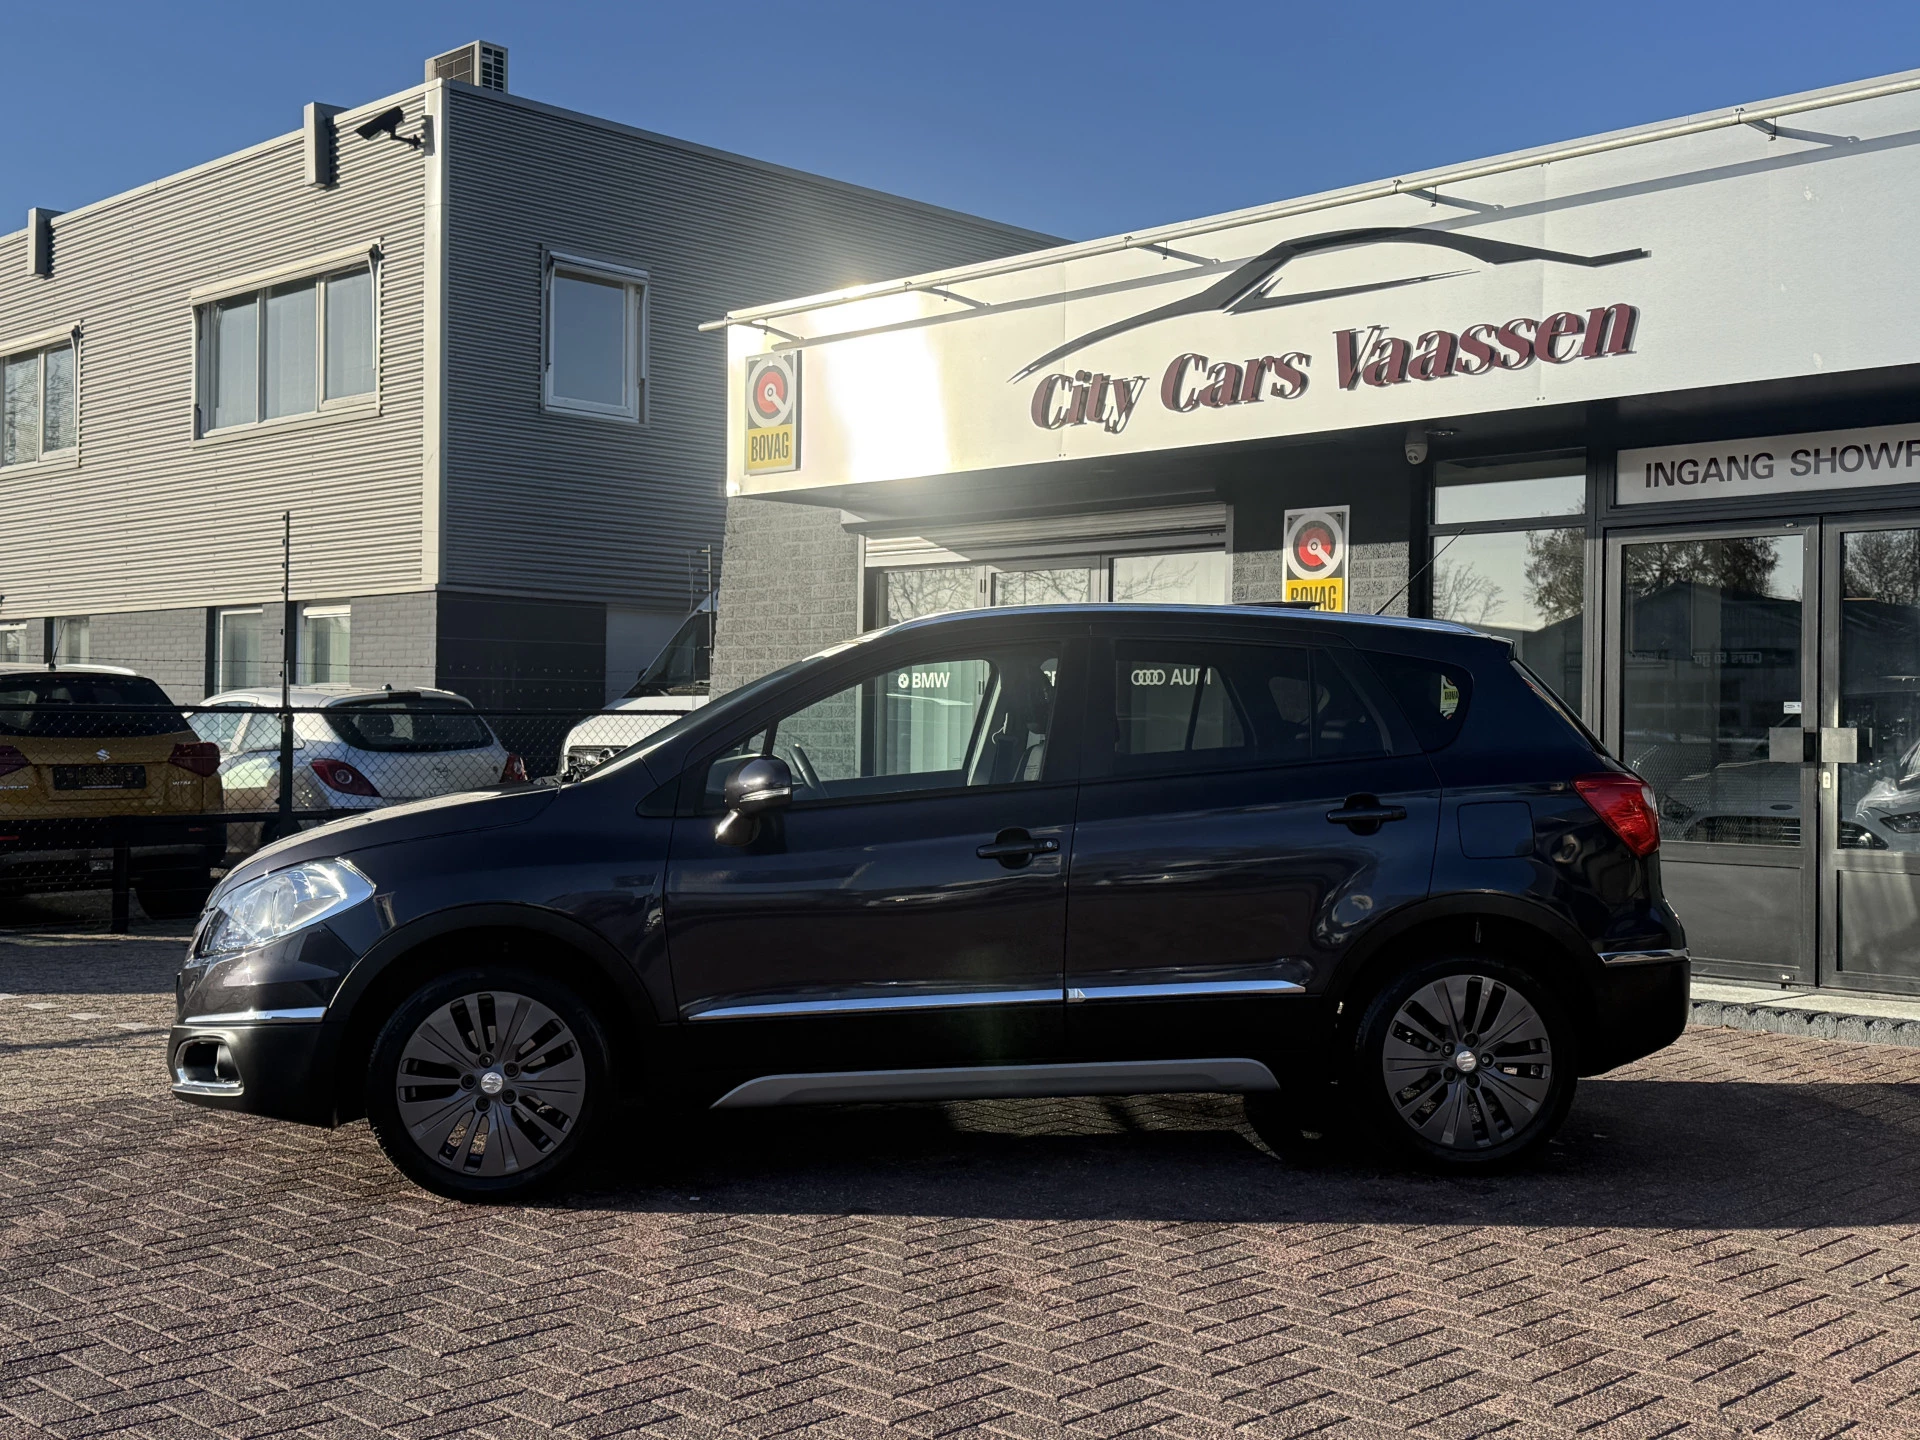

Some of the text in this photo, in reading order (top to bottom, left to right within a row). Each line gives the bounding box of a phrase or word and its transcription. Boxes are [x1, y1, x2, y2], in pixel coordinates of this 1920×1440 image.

[1031, 302, 1641, 434] City Cars Vaassen
[751, 432, 789, 462] BOVAG
[1645, 452, 1775, 488] INGANG
[912, 672, 950, 688] BMW
